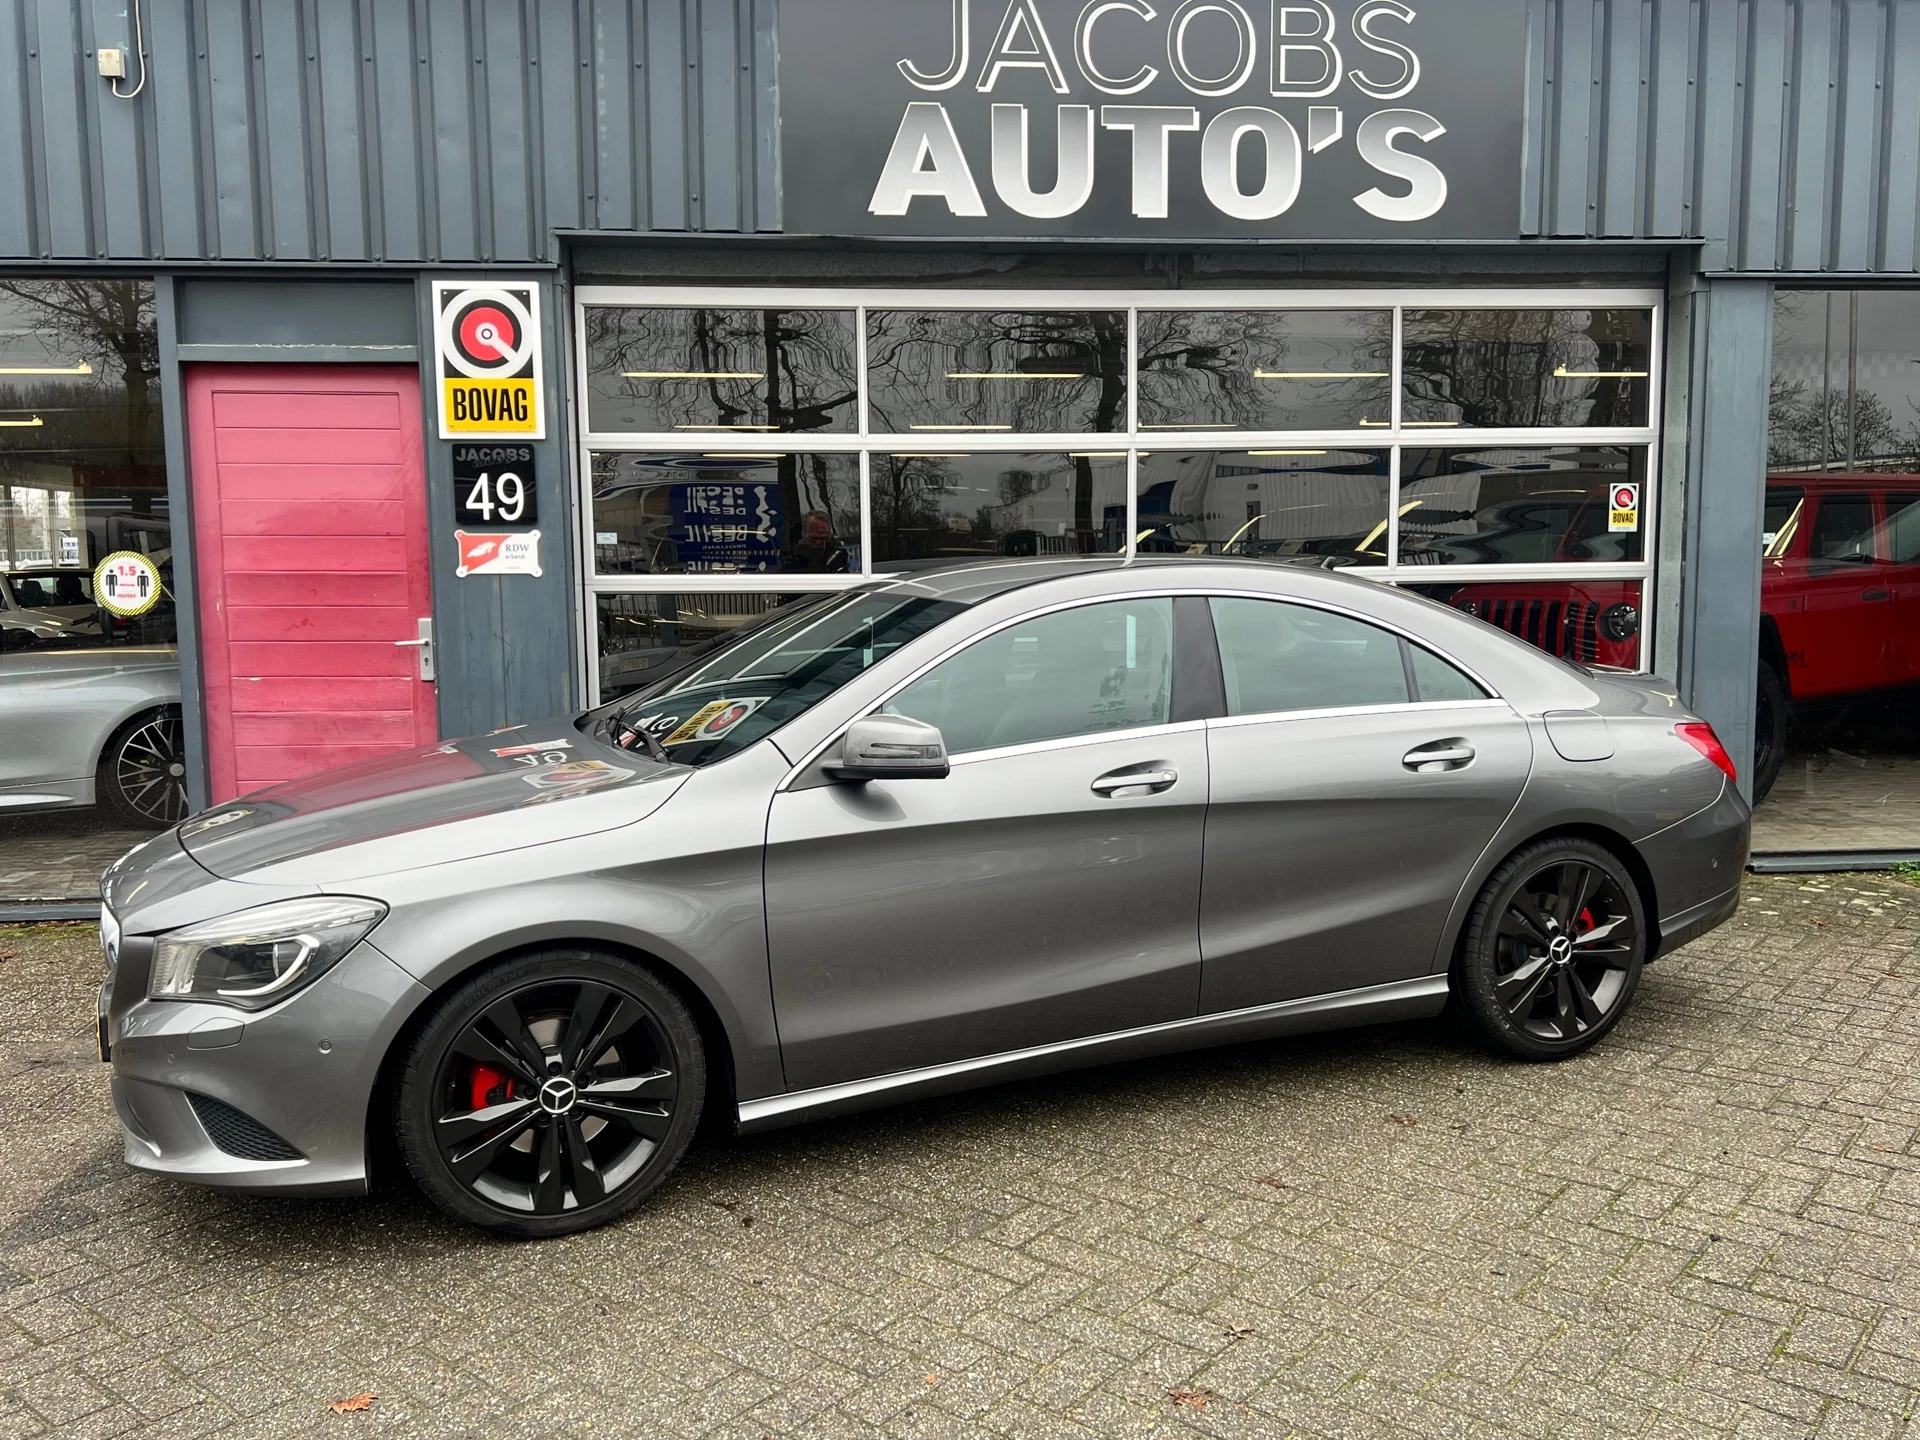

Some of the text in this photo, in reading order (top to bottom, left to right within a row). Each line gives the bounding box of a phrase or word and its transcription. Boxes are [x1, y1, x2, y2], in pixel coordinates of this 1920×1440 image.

[896, 0, 1421, 99] JACOBS
[867, 102, 1448, 221] AUTO'S
[452, 387, 528, 423] BOVAG
[455, 448, 531, 461] JACOBS
[465, 472, 525, 521] 49
[1612, 512, 1634, 523] BOVAG
[505, 543, 530, 552] RDW
[117, 565, 137, 577] 1.5
